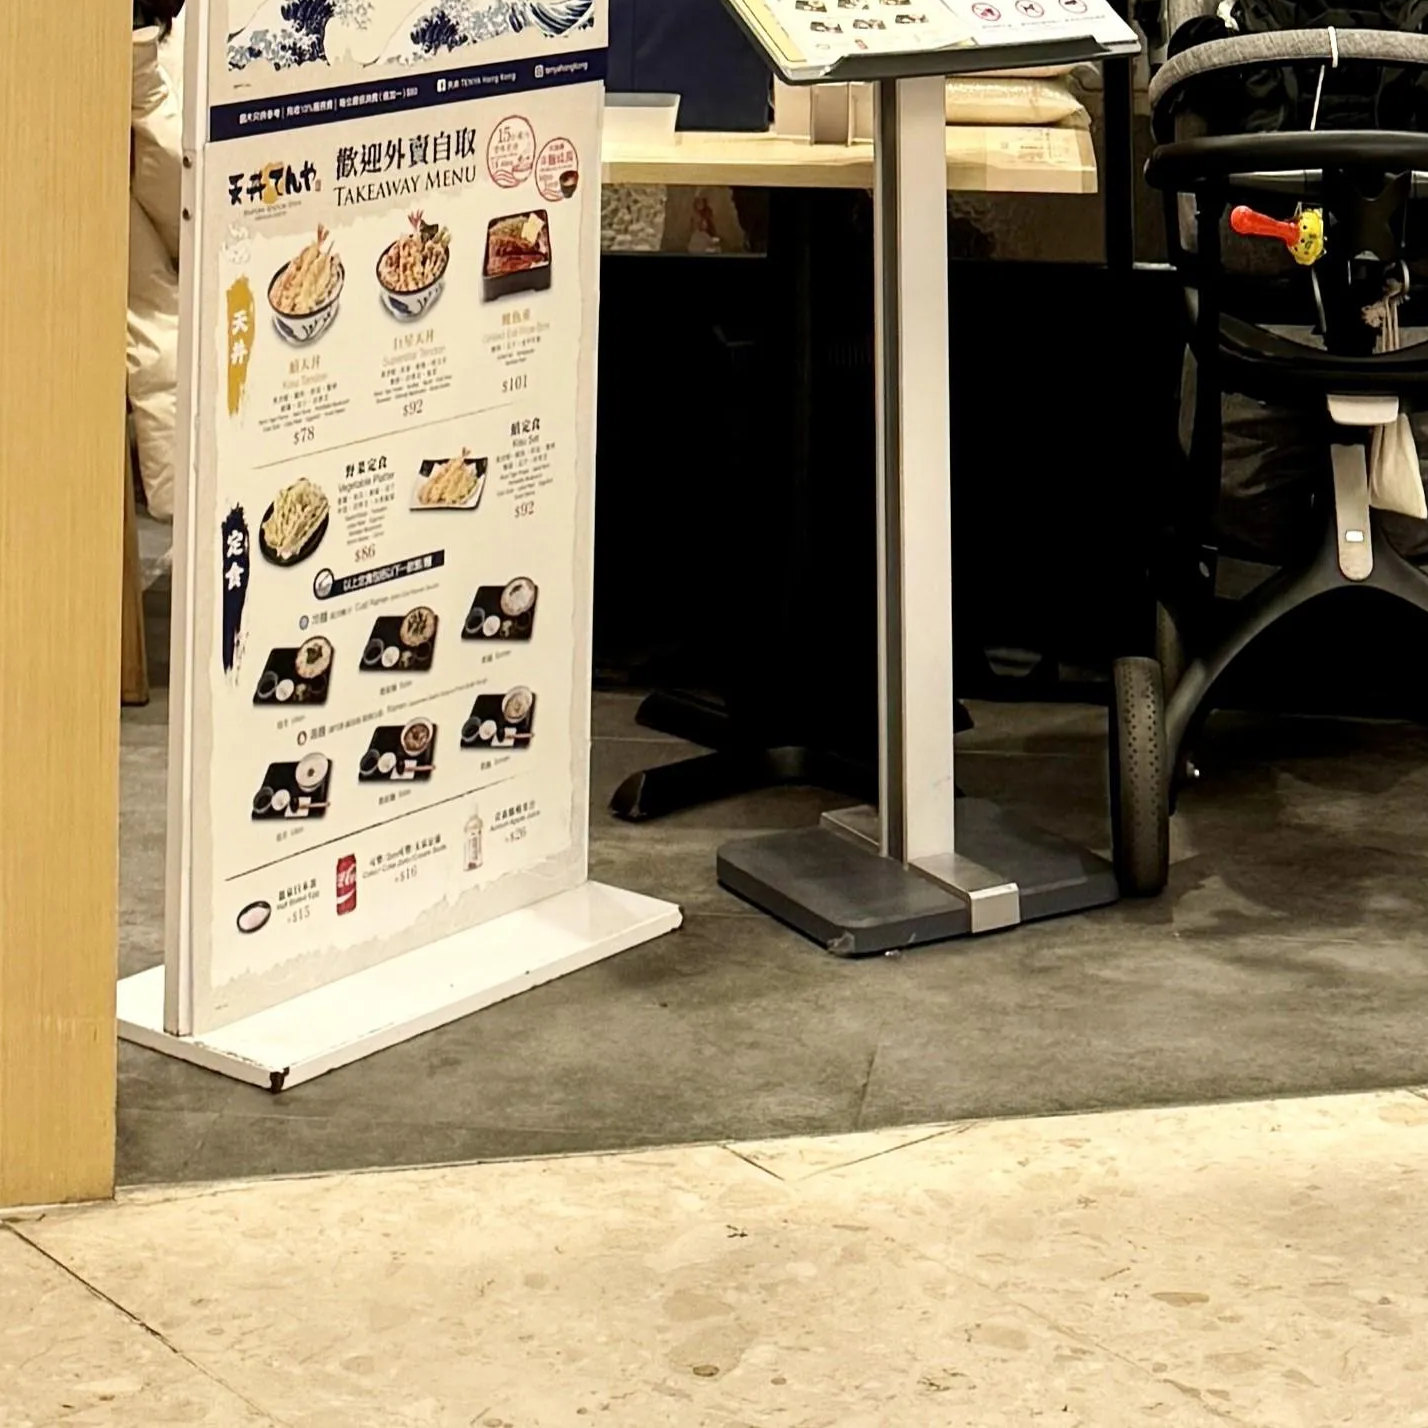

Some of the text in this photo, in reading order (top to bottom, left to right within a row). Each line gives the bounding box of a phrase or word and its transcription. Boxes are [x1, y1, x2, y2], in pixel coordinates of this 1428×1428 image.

[335, 127, 477, 181] 歡迎外賣自取
[228, 160, 318, 206] 天丼てんや
[332, 164, 477, 207] TAKEAWAY MENU
[502, 375, 529, 394] $101
[402, 399, 423, 417] $92
[293, 426, 316, 445] $78
[513, 501, 536, 518] $92
[226, 529, 245, 591] 定食
[354, 544, 376, 563] $86
